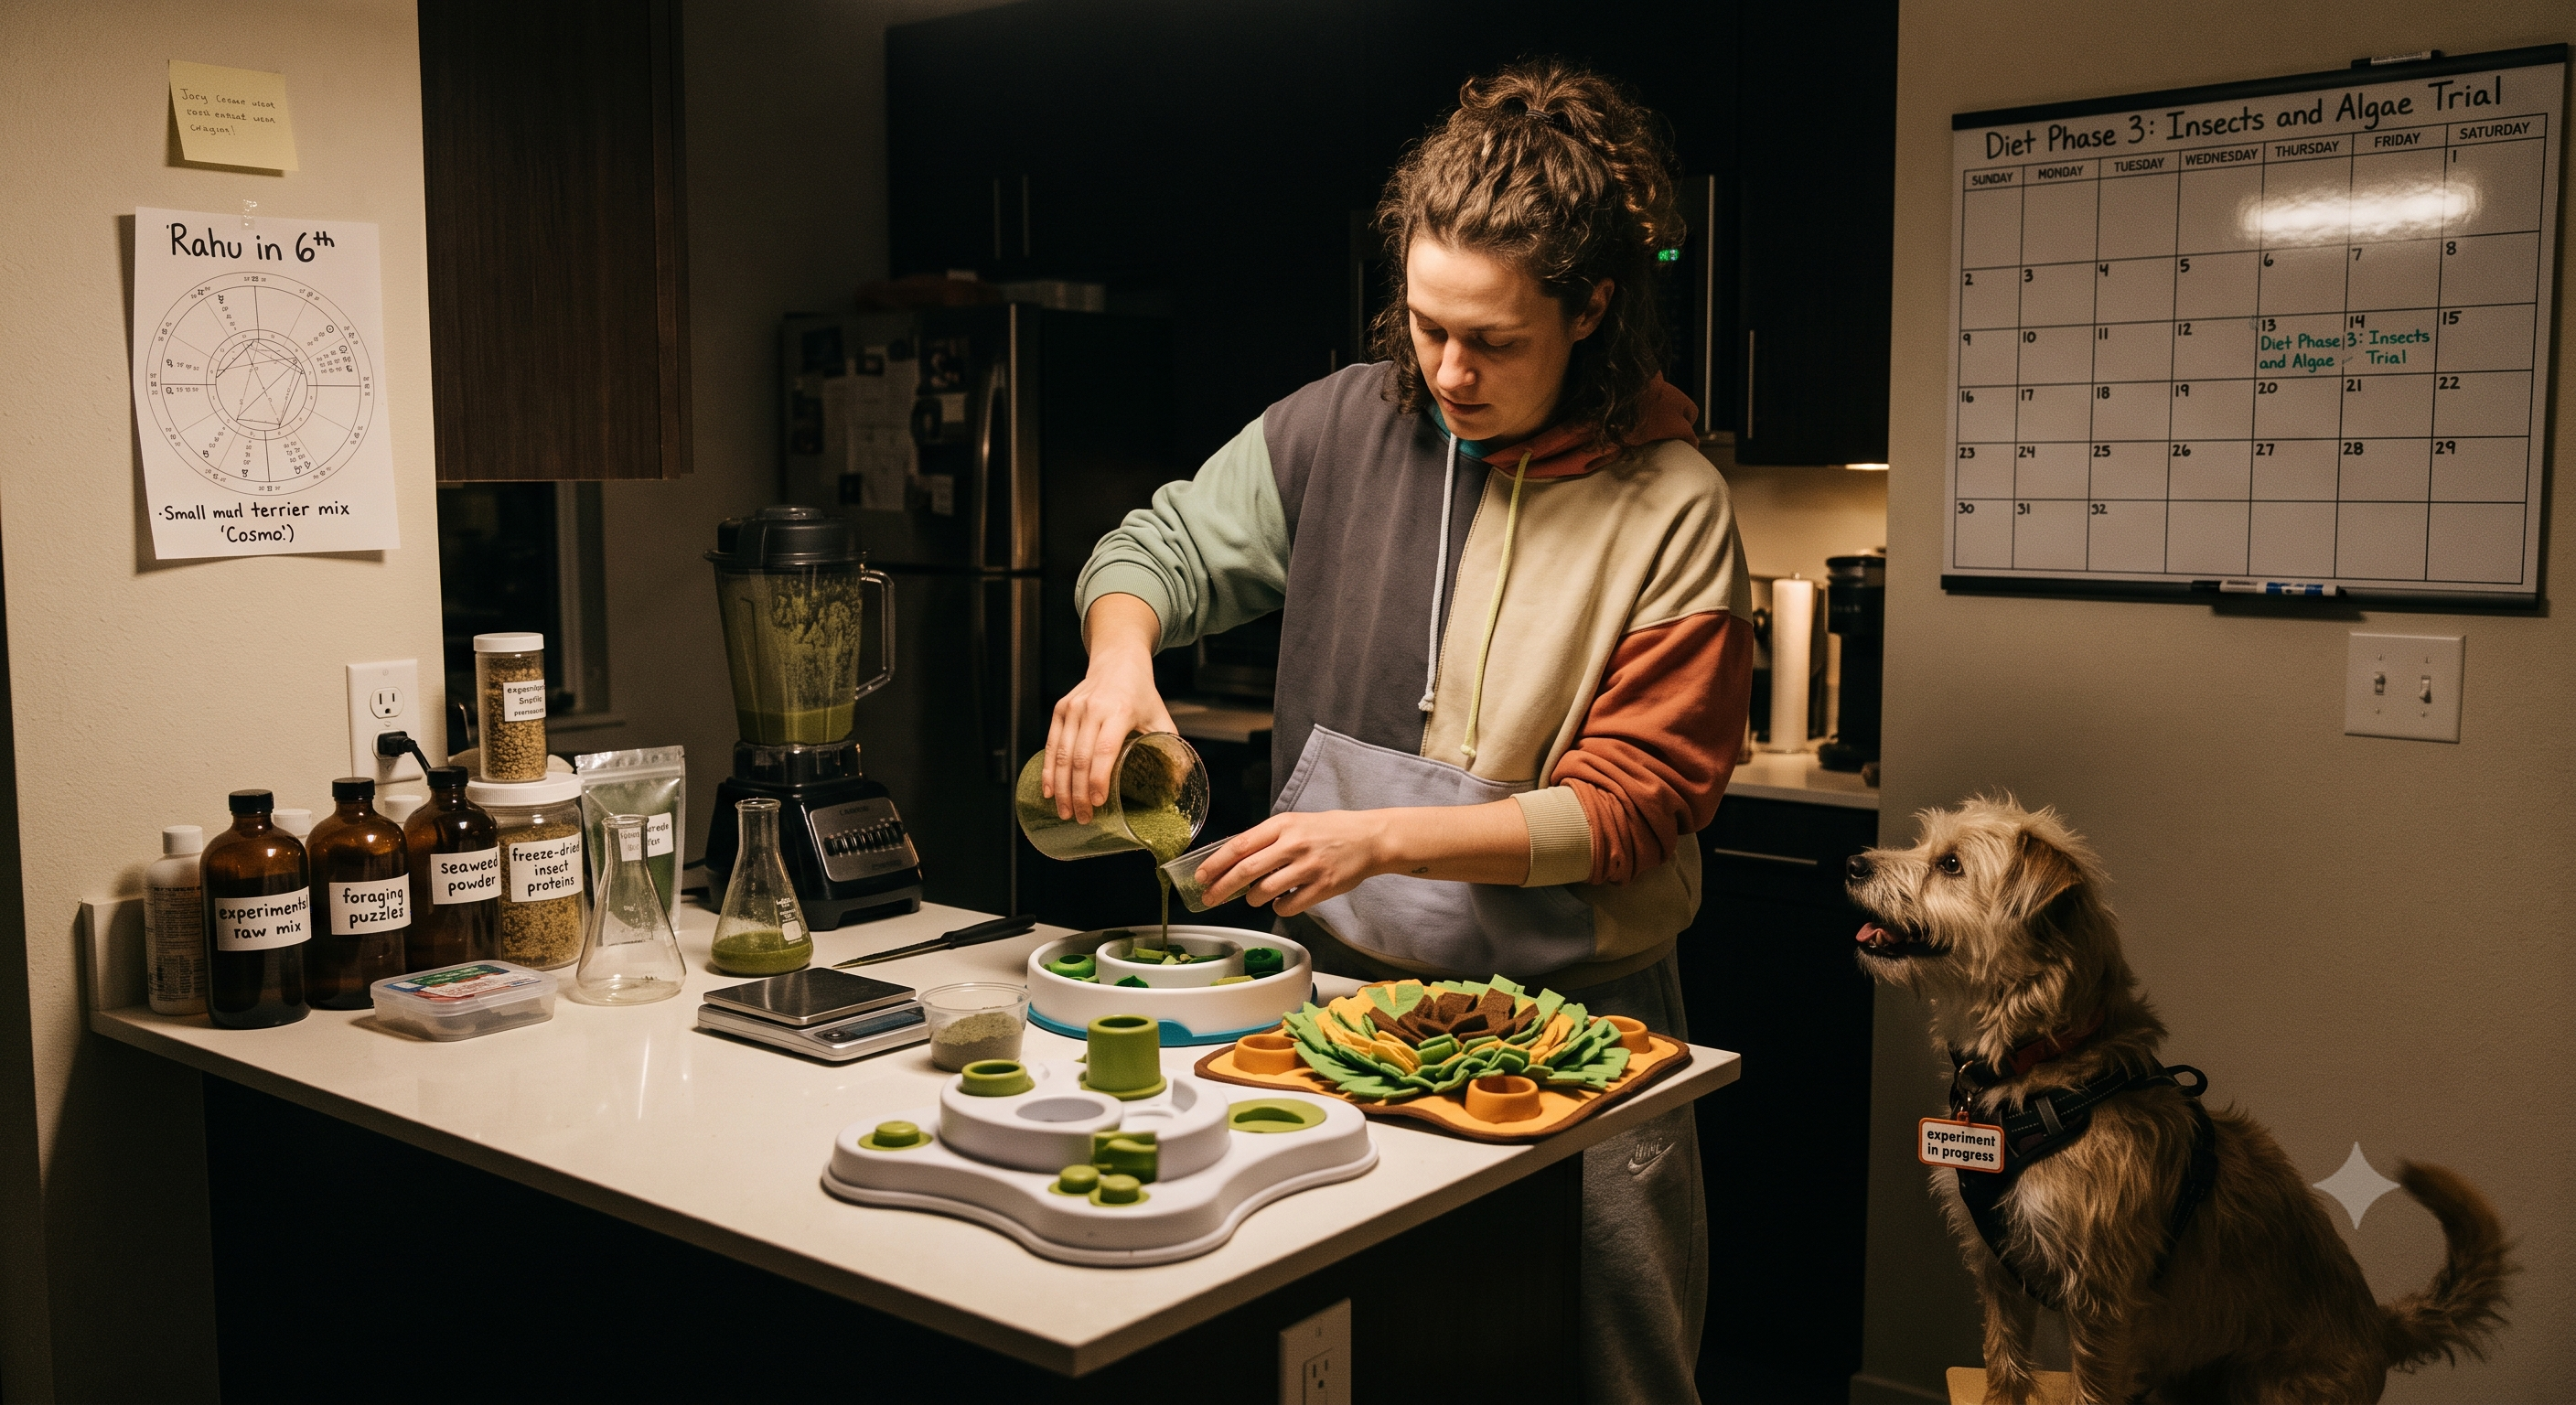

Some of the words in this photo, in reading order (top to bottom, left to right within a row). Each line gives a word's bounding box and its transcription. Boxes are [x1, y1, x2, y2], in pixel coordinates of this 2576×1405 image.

[1986, 130, 2036, 160] Diet
[2048, 123, 2118, 152] Phase
[2128, 115, 2155, 144] 3:
[2166, 106, 2265, 140] Insects
[2276, 98, 2323, 127] and
[2335, 92, 2414, 131] Algae
[2428, 75, 2502, 112] Trial
[1971, 172, 2014, 186] SUNDAY
[2038, 166, 2085, 180] MONDAY
[2114, 157, 2165, 172] TUESDAY
[2185, 148, 2259, 166] WEDNESDAY
[2275, 141, 2340, 157] THURSDAY
[2374, 133, 2421, 148] FRIDAY
[2459, 122, 2531, 140] SATURDAY
[2453, 149, 2457, 163] 1
[256, 235, 282, 261] in
[295, 231, 335, 263] 6th
[1964, 273, 1973, 286] 2
[2023, 268, 2034, 283] 3
[2098, 263, 2109, 277] 4
[2179, 258, 2191, 273] 5
[2263, 252, 2274, 267] 6
[2352, 248, 2362, 261] 7
[2445, 241, 2457, 256] 8
[1962, 333, 1971, 346] 9
[2023, 330, 2037, 344] 10
[2098, 327, 2109, 339] 11
[2177, 322, 2193, 336] 12
[2261, 318, 2277, 332] 13
[2349, 315, 2366, 328] 14
[2442, 311, 2463, 325] 15
[2261, 335, 2292, 351] Diet
[2298, 333, 2341, 349] Phase
[2347, 332, 2364, 347] 3:
[2369, 329, 2431, 345] Insects
[2259, 354, 2286, 370] and
[2292, 353, 2334, 373] Algae
[2366, 349, 2407, 365] Trial
[1961, 390, 1974, 403] 16
[2021, 389, 2034, 401] 17
[2097, 386, 2110, 400] 18
[2175, 383, 2189, 397] 19
[2258, 381, 2278, 394] 20
[2345, 379, 2362, 392] 21
[2439, 376, 2461, 390] 22
[1959, 446, 1975, 458] 23
[2018, 445, 2035, 458] 24
[2093, 445, 2110, 457] 25
[2172, 444, 2191, 456] 26
[2256, 443, 2275, 456] 27
[2343, 442, 2364, 456] 28
[2435, 440, 2456, 455] 29
[251, 502, 309, 518] terrier
[318, 501, 350, 516] mix
[1958, 502, 1975, 514] 30
[2017, 502, 2031, 515] 31
[2091, 503, 2108, 515] 32
[512, 835, 580, 862] freeze-dried
[441, 852, 499, 874] seaweed
[534, 861, 569, 876] insect
[448, 874, 496, 897] powder
[527, 876, 574, 897] proteins
[342, 887, 403, 908] foraging
[349, 906, 403, 929] puzzles
[234, 928, 266, 939] raw
[276, 920, 301, 935] mix
[1927, 1131, 1995, 1147] experiment
[1927, 1142, 1938, 1155] in
[1942, 1147, 1994, 1163] progress
